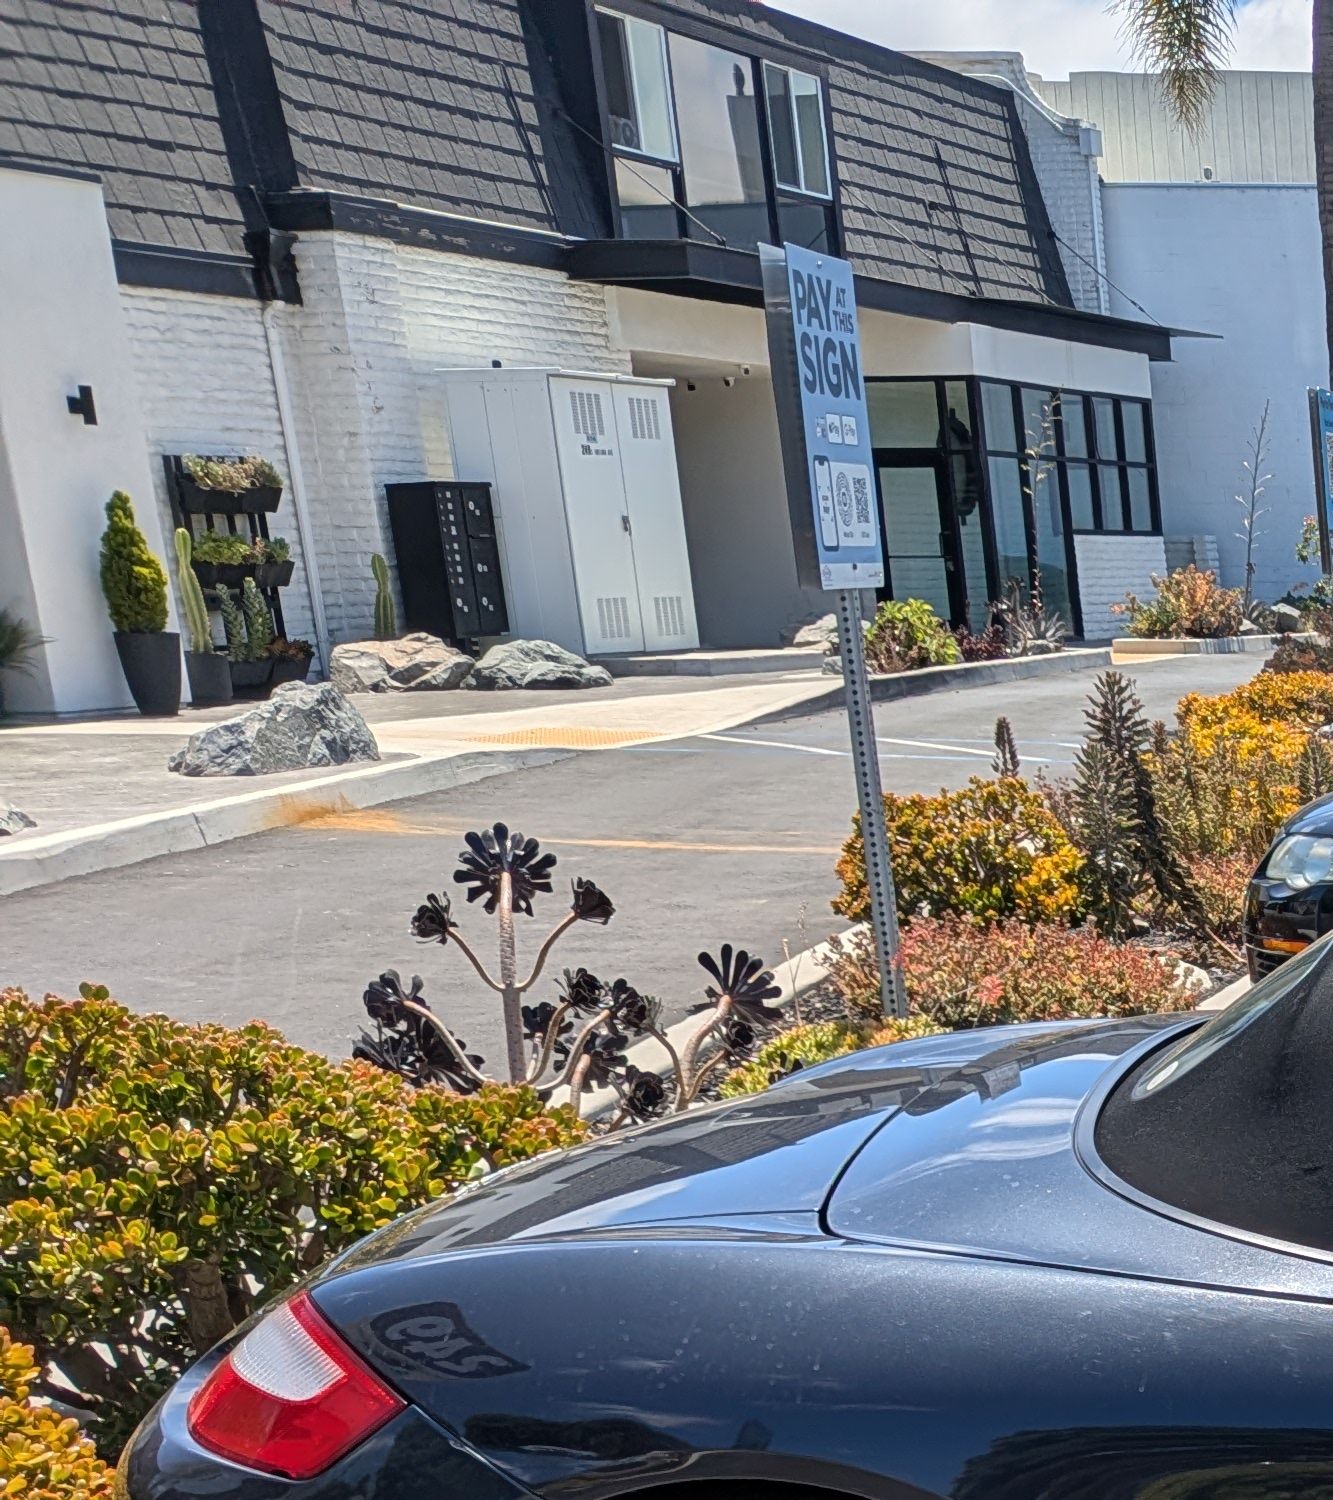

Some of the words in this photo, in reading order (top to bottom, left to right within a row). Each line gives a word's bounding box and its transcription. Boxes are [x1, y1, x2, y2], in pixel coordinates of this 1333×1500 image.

[792, 268, 832, 332] PAY
[835, 286, 846, 308] AT
[832, 310, 854, 334] THIS
[801, 331, 861, 401] SIGN
